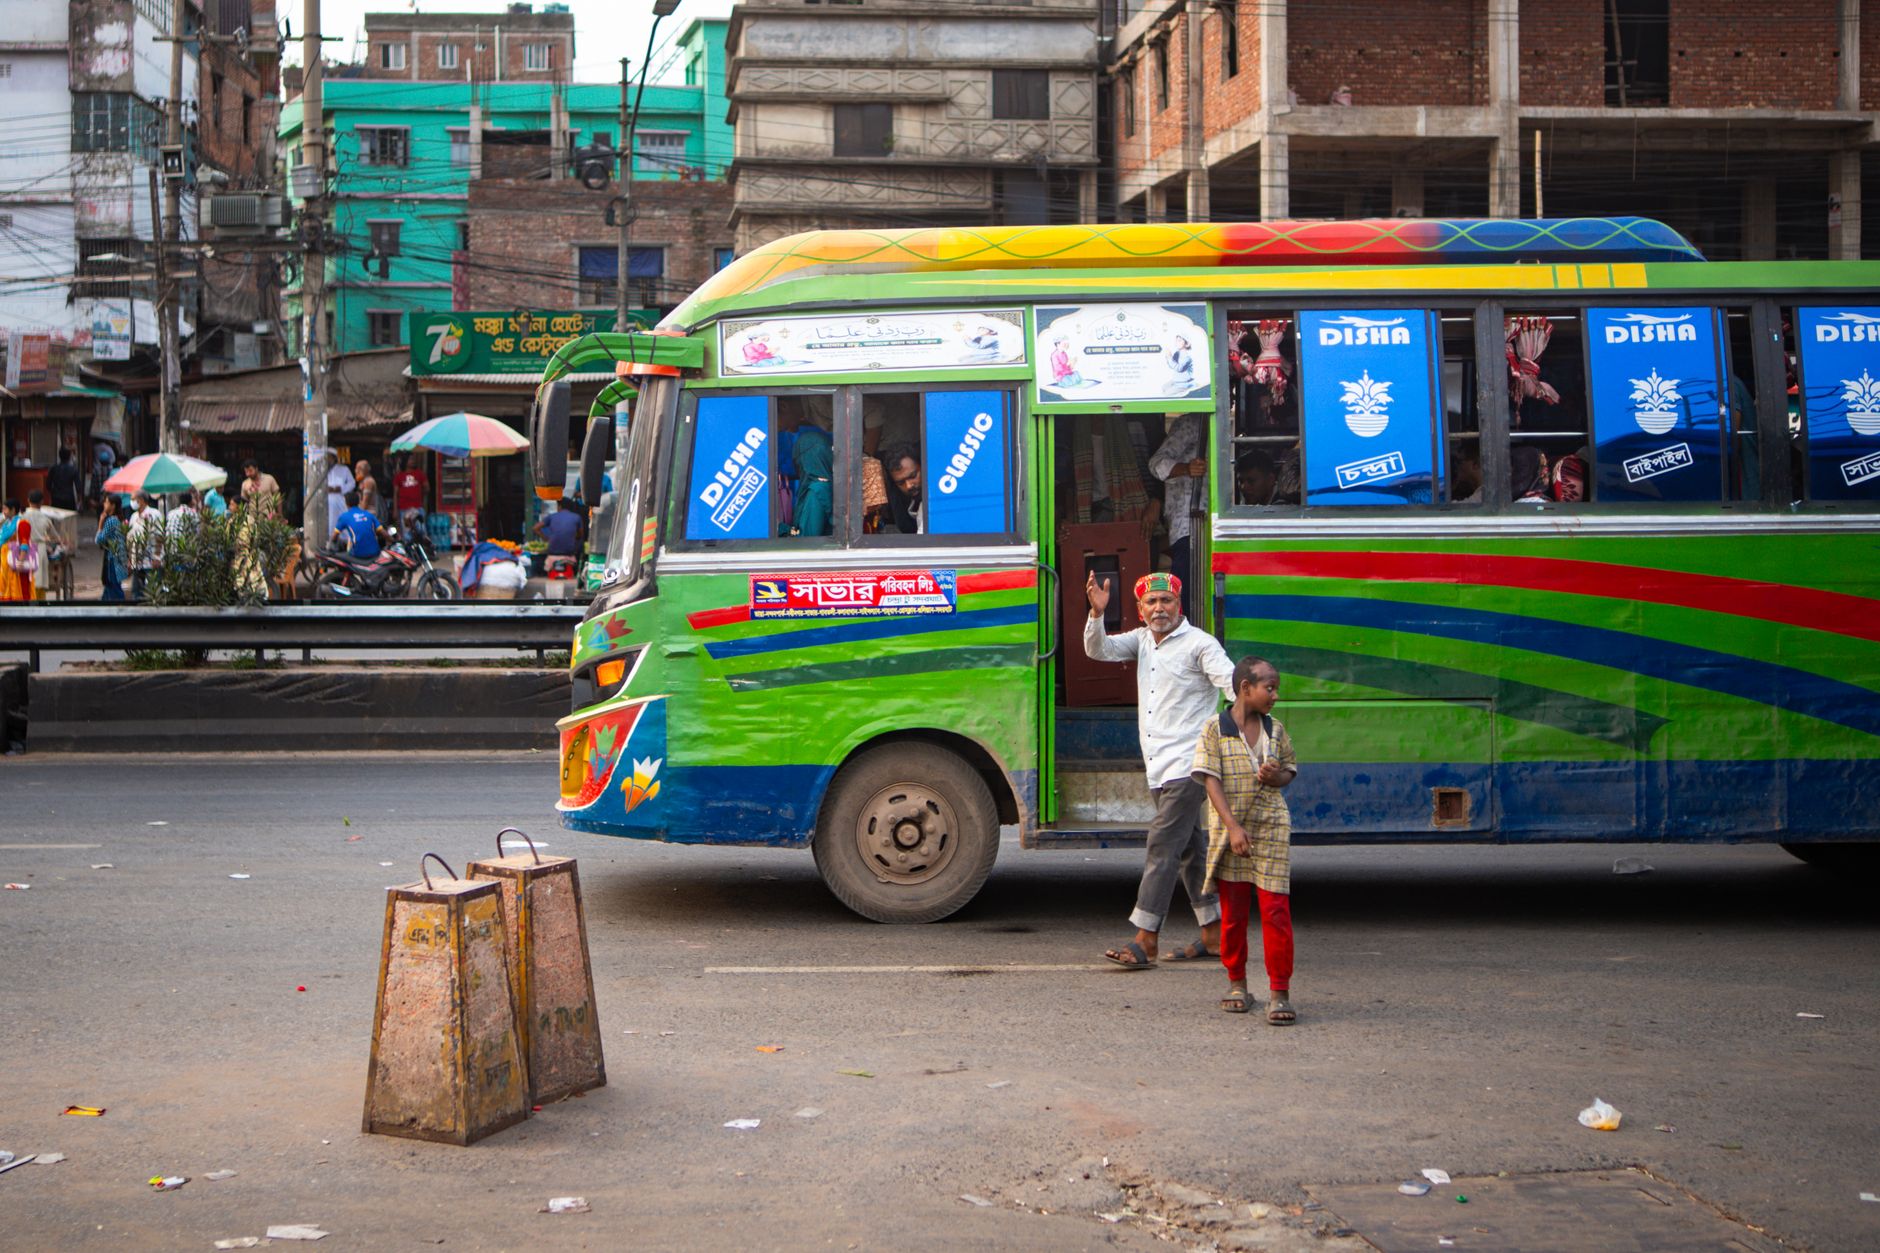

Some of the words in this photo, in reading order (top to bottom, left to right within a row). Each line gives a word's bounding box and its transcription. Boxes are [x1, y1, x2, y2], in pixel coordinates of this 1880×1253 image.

[551, 313, 596, 333] হোটেল
[1319, 326, 1411, 346] DISHA
[1605, 324, 1697, 344] DISHA
[938, 412, 993, 494] CLASSIC
[1628, 449, 1688, 477] বাইপাইল
[700, 427, 767, 508] DISHA
[1340, 456, 1399, 482] চন্দ্রা
[717, 472, 760, 524] সদরঘাট
[789, 580, 878, 605] সাভার
[880, 576, 917, 594] পরিবহন
[917, 575, 934, 592] লিঃ
